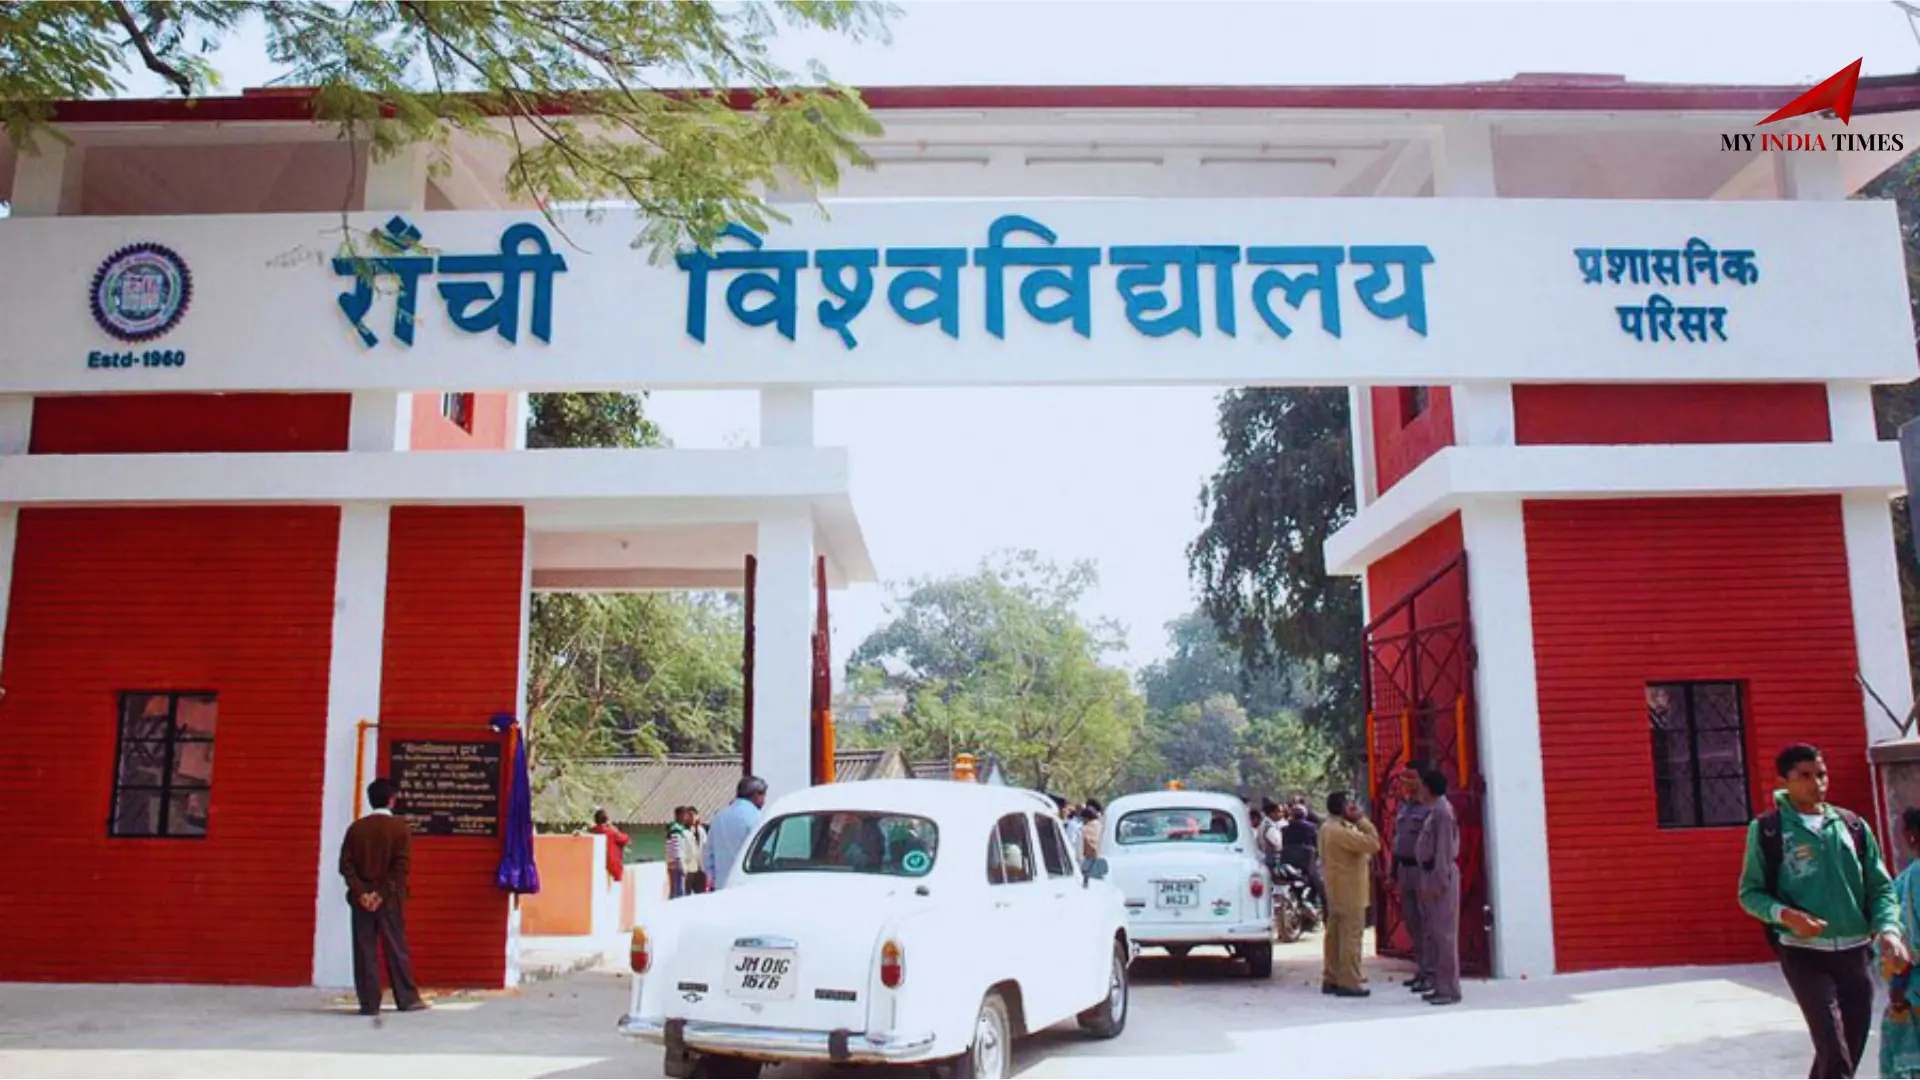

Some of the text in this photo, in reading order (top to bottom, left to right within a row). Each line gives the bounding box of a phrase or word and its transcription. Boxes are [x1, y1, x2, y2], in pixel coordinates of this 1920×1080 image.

[674, 215, 1435, 350] विश्वविद्यालय
[1574, 237, 1759, 285] प्रशासनिक
[1615, 293, 1728, 342] परिसर
[88, 350, 186, 368] Estd-1960
